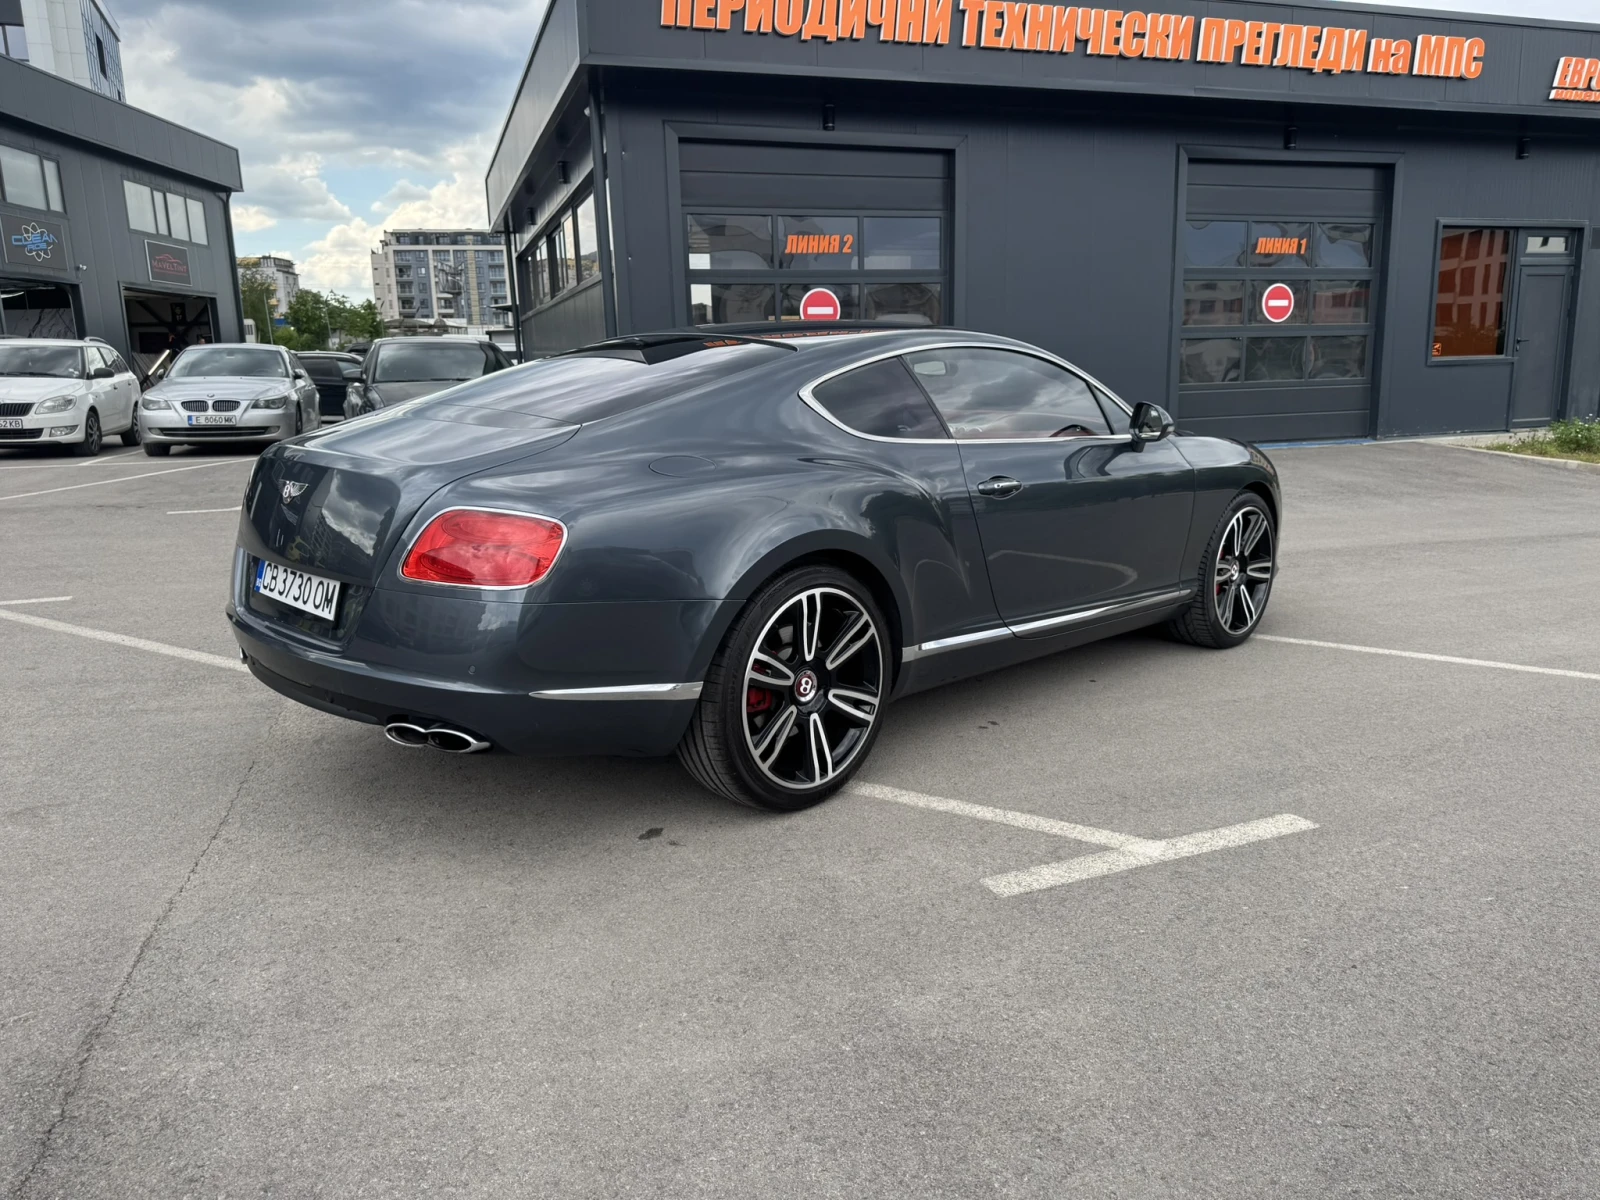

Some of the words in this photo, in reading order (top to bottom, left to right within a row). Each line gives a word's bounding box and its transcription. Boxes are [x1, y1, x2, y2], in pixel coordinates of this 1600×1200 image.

[660, 0, 952, 44] ПЕРИОДИЧНИ
[959, 0, 1195, 60] ТЕХНИЧЕСКИ
[1196, 17, 1368, 74] ПРЕГЛЕДИ
[1367, 38, 1412, 74] на
[1412, 34, 1485, 79] МПС
[785, 234, 840, 254] ЛИНИЯ
[843, 234, 854, 254] 2
[1255, 237, 1299, 254] ЛИНИЯ
[1300, 238, 1307, 254] 1
